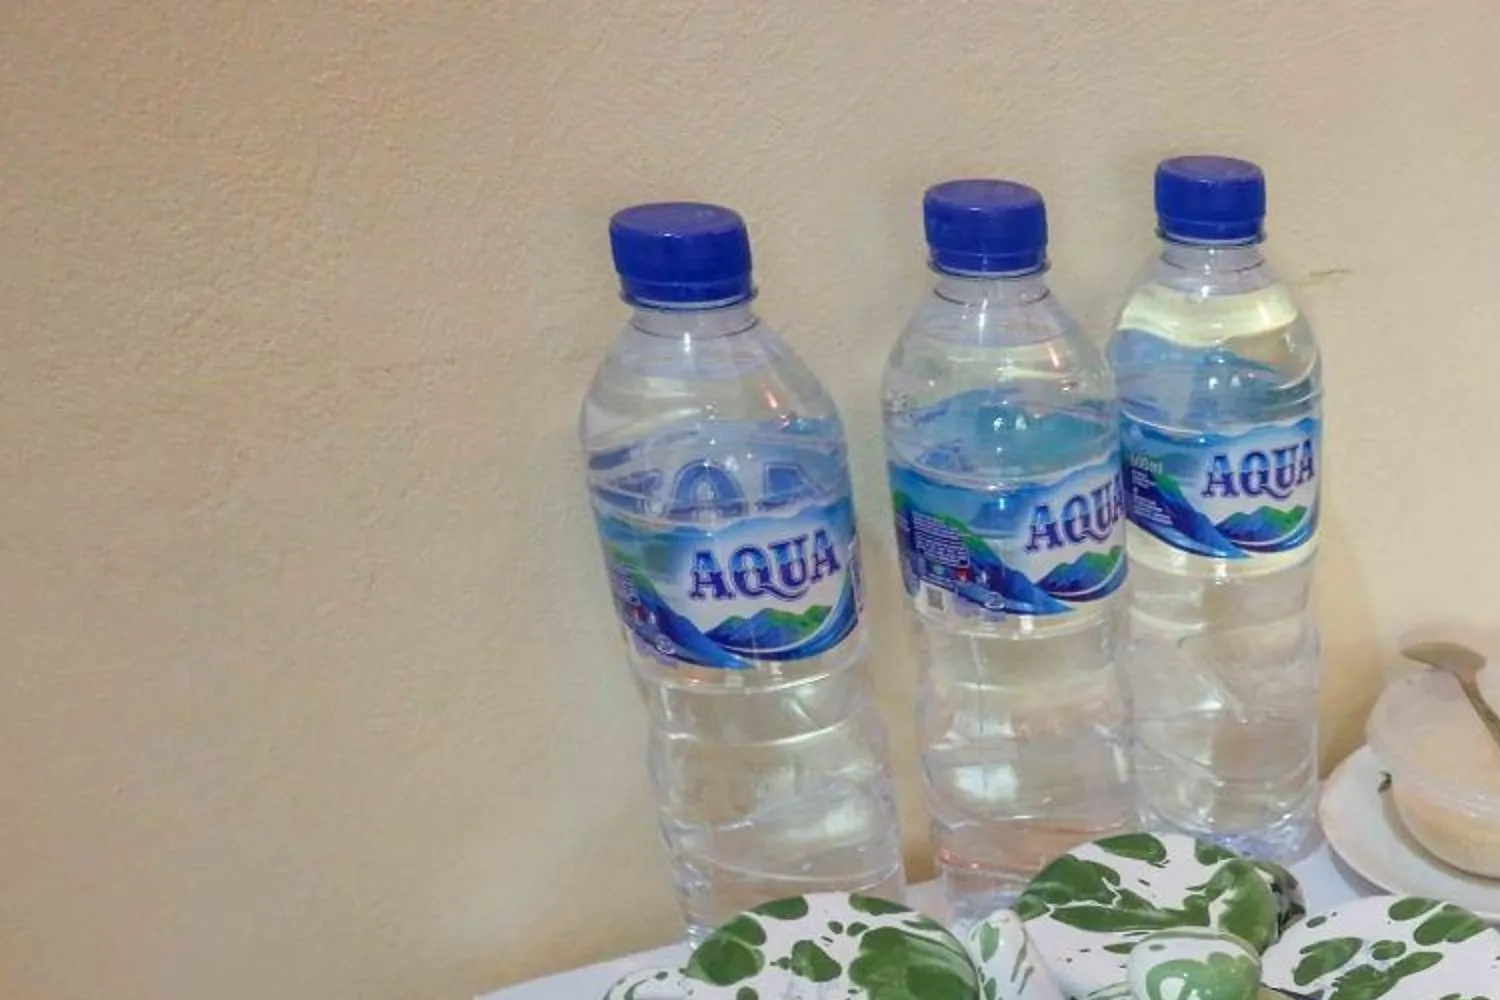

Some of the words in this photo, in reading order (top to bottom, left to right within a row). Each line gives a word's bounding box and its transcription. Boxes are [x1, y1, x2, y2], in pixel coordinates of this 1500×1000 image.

[1202, 438, 1315, 500] AQUA
[1025, 470, 1126, 552] AQUA
[689, 528, 841, 602] AQUA
